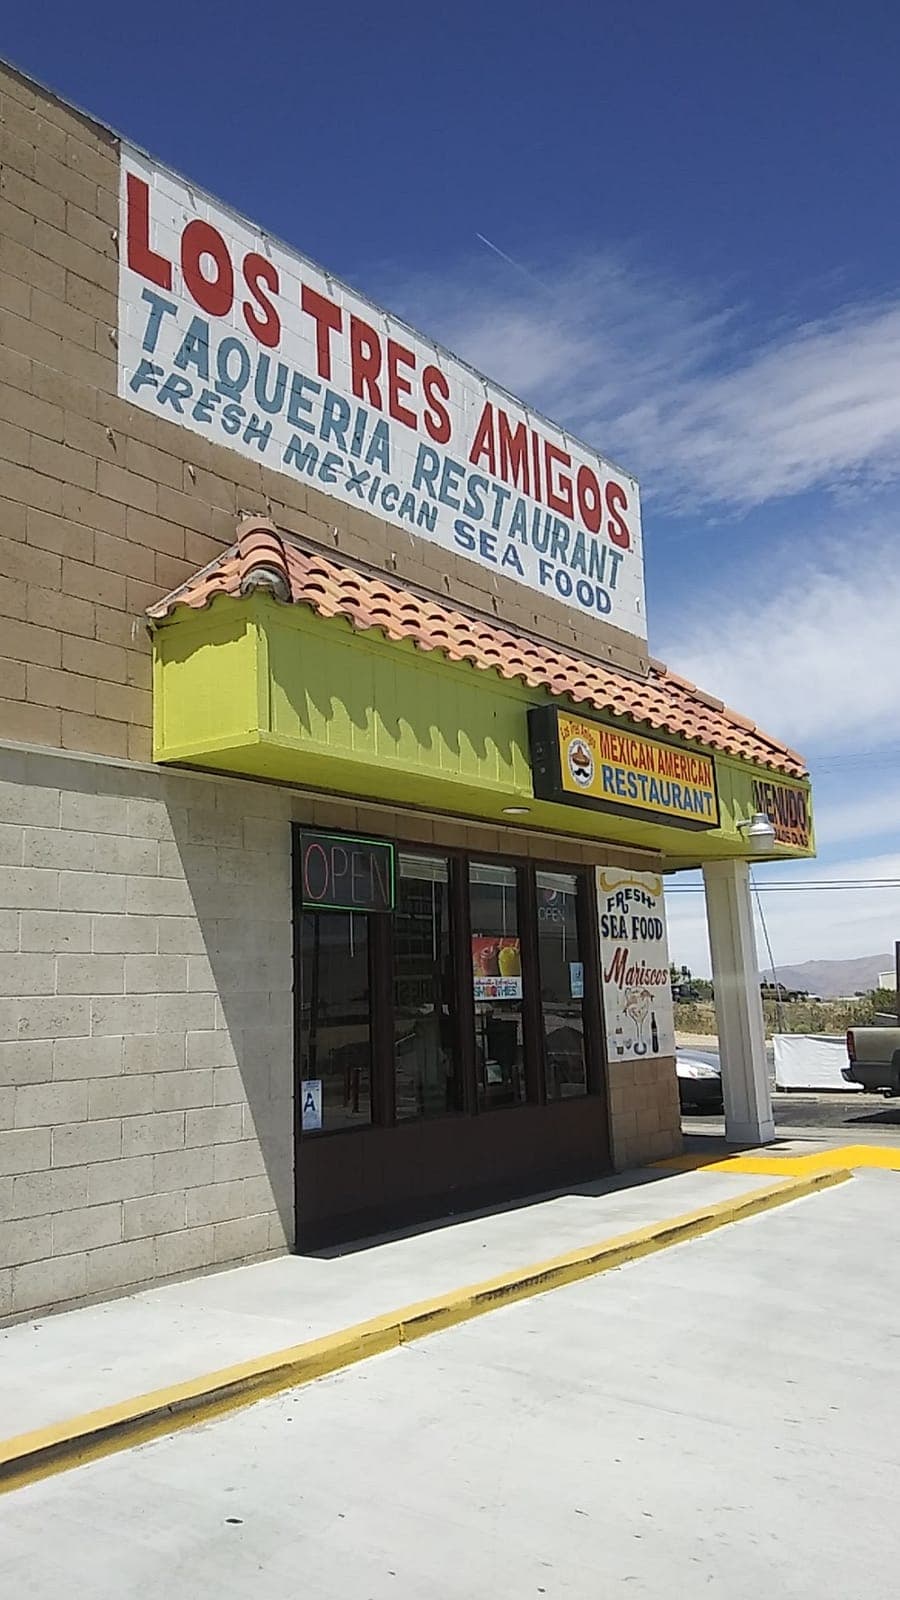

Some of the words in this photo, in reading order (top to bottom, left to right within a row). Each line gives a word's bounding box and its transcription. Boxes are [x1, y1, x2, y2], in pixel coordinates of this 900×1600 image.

[127, 172, 281, 348] LOS
[301, 283, 452, 444] TRES
[469, 401, 631, 550] AMIGOS
[142, 288, 390, 475] TAQUERIA
[412, 442, 624, 590] RESTAURANT
[129, 359, 273, 452] FRESH
[283, 434, 439, 533] MEXICAN
[454, 519, 525, 577] SEA
[539, 558, 611, 615] FOOD
[599, 730, 655, 772] MEXICAN
[657, 749, 712, 788] AMERICAN
[602, 764, 713, 817] RESTAURANT
[304, 843, 390, 906] OPEN
[606, 888, 656, 914] FRESH
[537, 907, 565, 922] OPEN
[601, 914, 629, 939] SEA
[631, 916, 663, 940] FOOD
[604, 947, 669, 989] Mariscos
[304, 1093, 316, 1112] A
